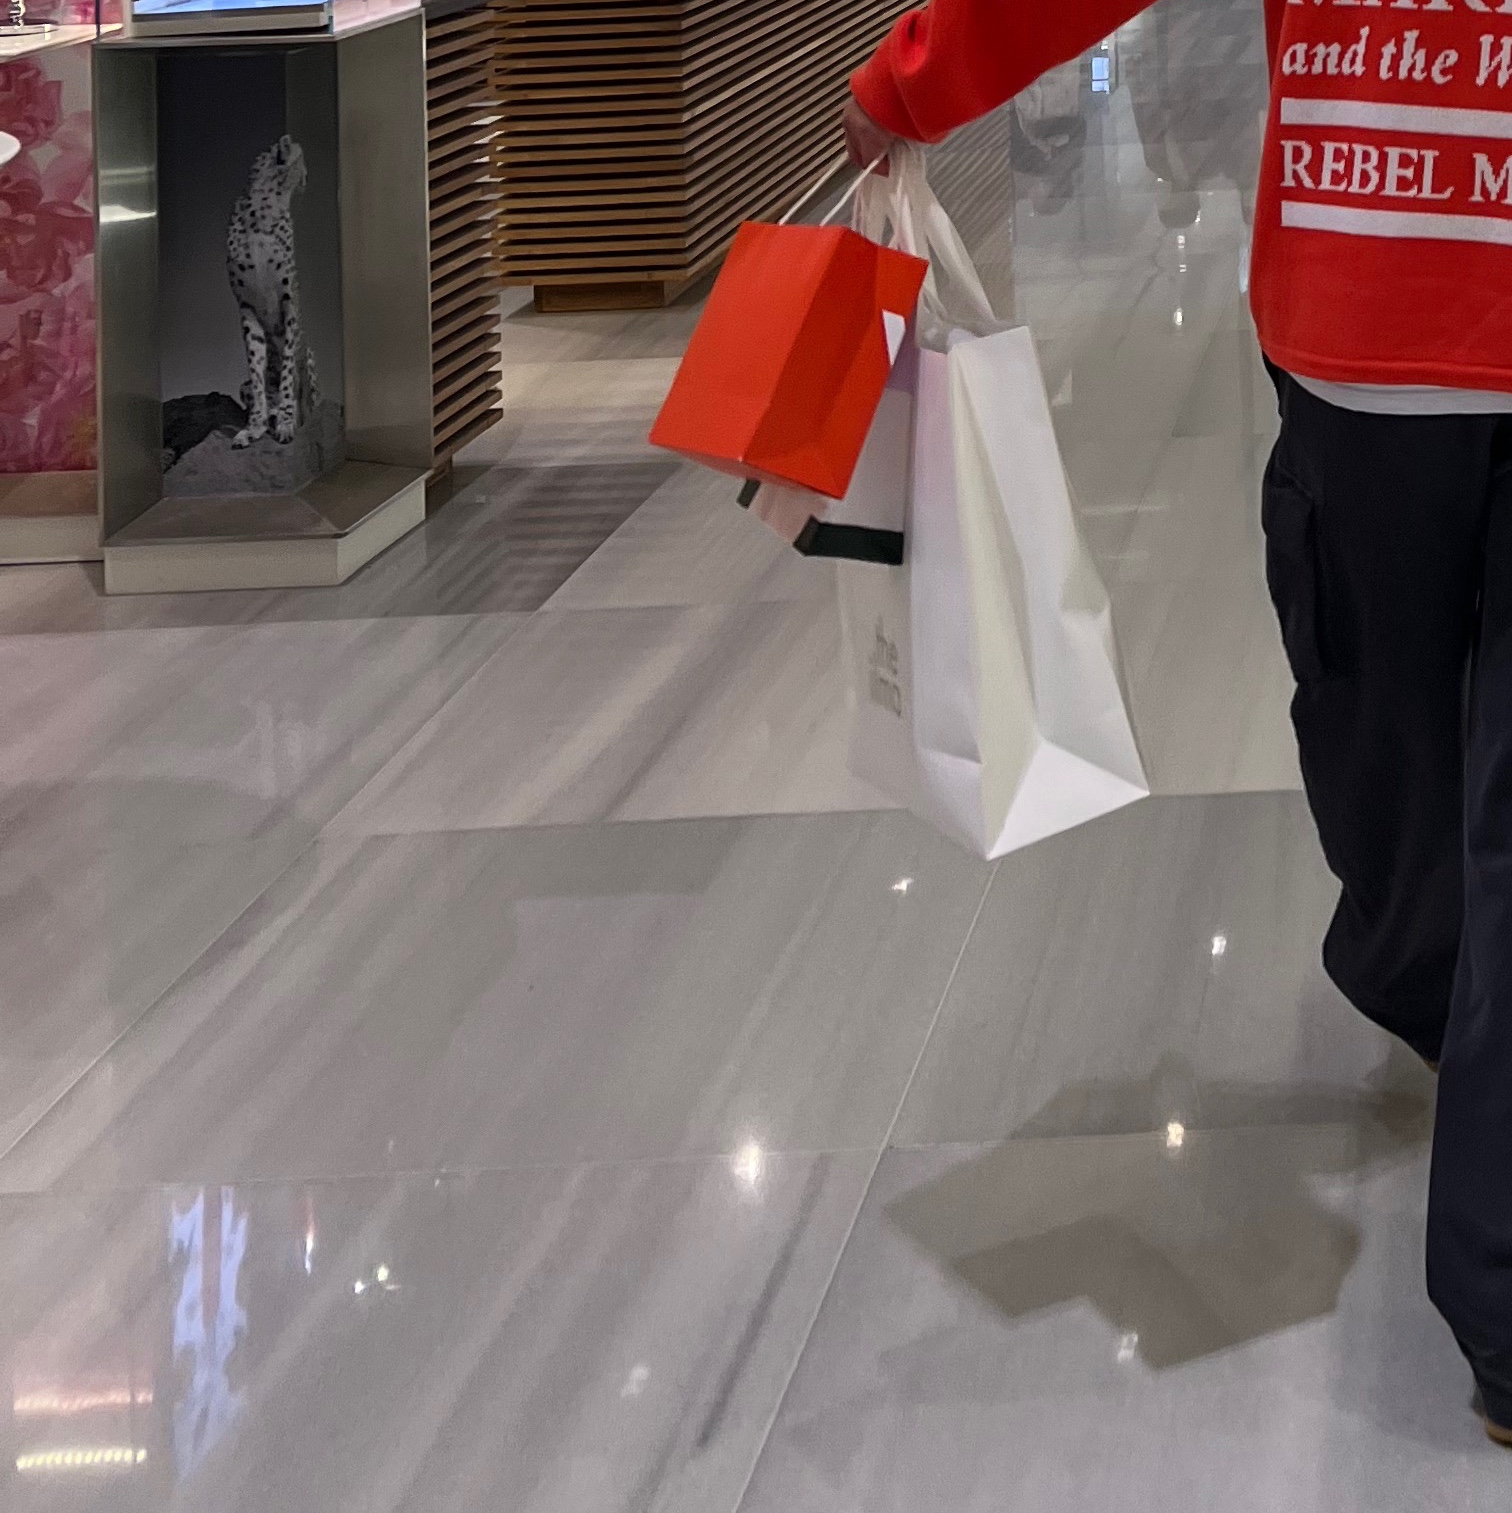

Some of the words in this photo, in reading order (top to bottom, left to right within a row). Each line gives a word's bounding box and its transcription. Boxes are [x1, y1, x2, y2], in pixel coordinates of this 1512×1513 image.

[1281, 26, 1371, 78] and
[1379, 29, 1459, 86] the
[1280, 140, 1455, 200] REBEL
